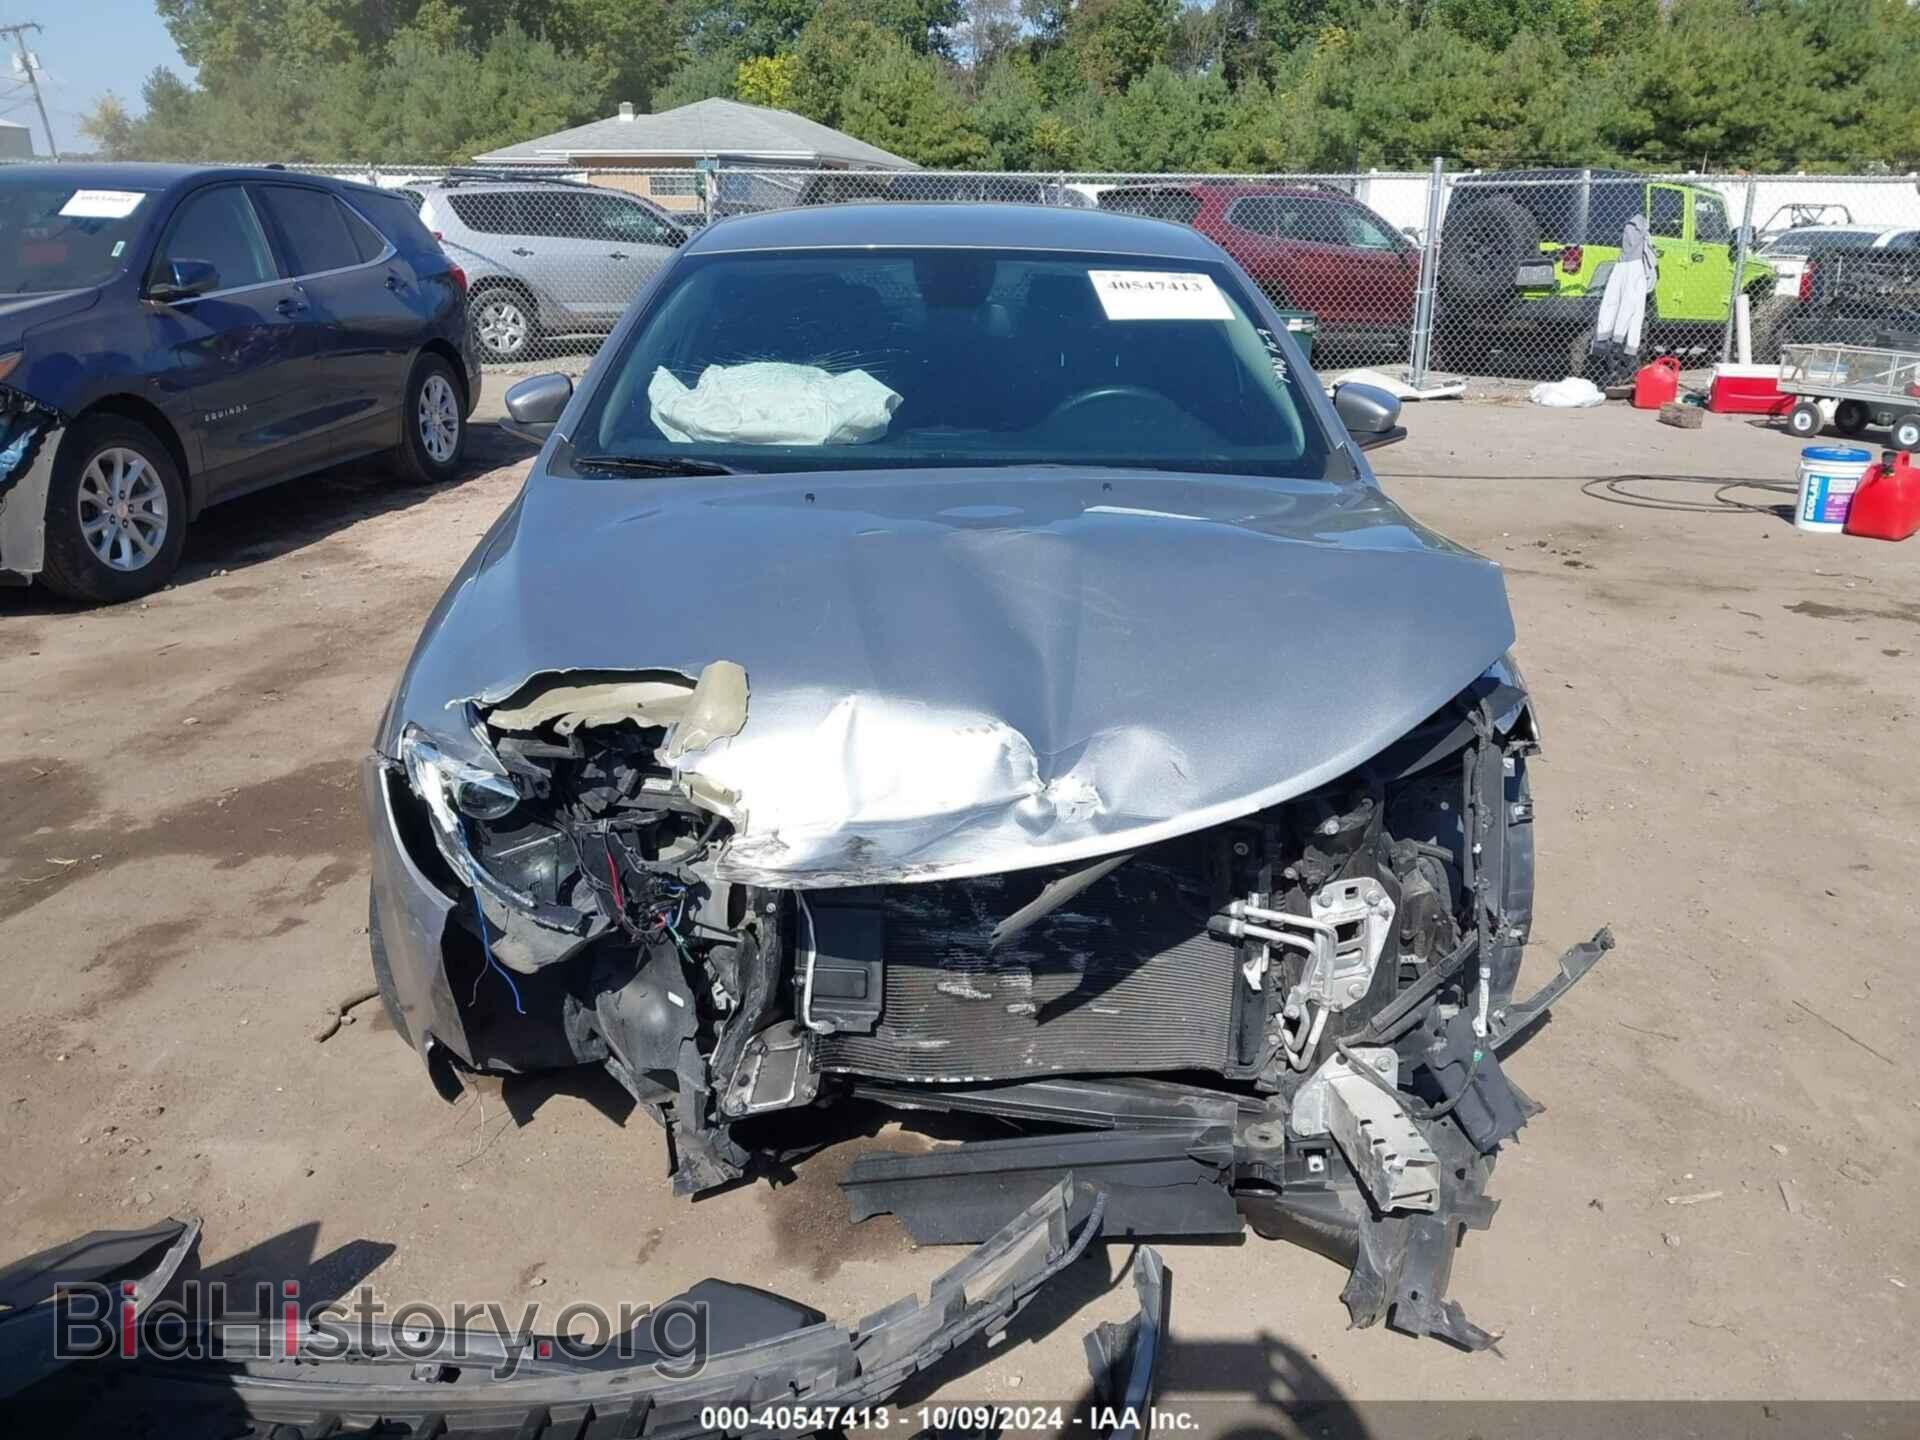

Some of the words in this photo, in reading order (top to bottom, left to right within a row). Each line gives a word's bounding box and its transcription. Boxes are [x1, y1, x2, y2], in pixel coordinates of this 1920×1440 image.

[1107, 280, 1204, 292] 40547413
[204, 404, 248, 422] EQUINOX
[1805, 476, 1821, 520] ECOLAB
